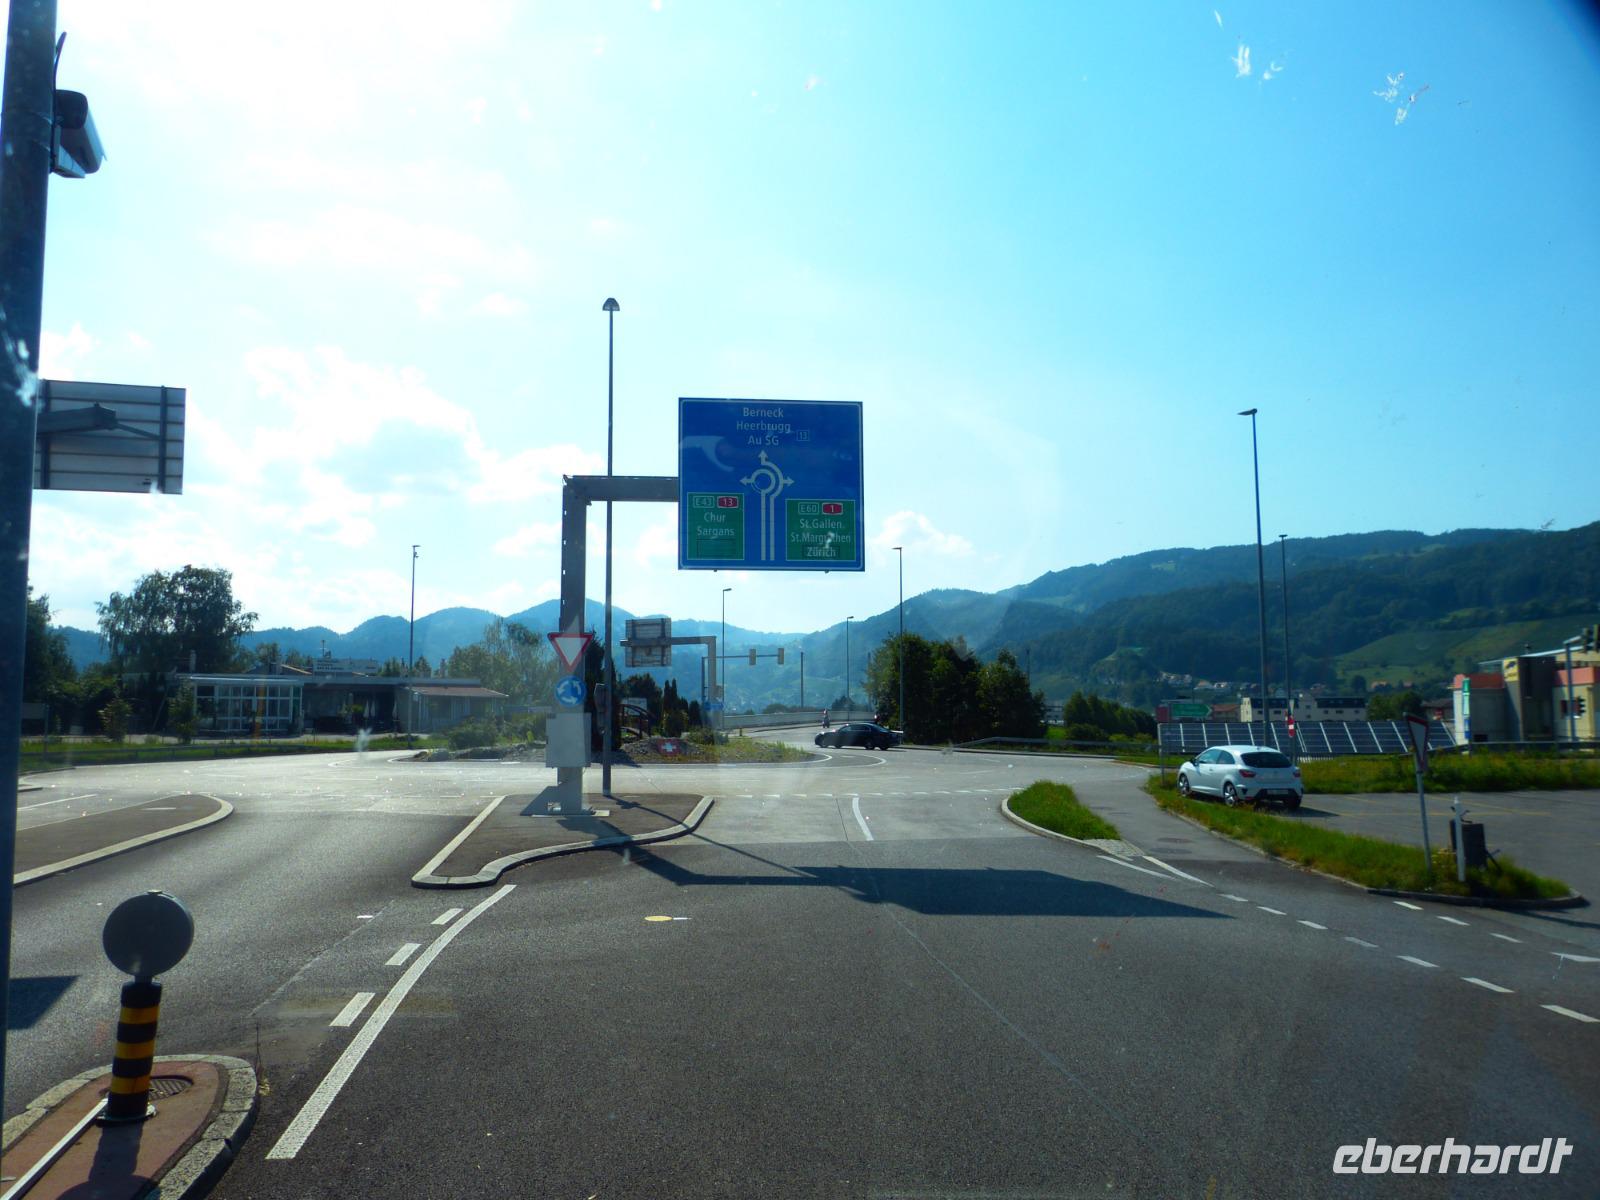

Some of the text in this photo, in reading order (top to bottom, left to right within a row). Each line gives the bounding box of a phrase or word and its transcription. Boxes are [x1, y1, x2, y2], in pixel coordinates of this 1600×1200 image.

[743, 407, 784, 418] Berneck
[736, 420, 791, 434] Heerbrugg
[747, 435, 780, 446] Au SG
[703, 511, 727, 523] Chur
[696, 526, 735, 540] Sargans
[790, 531, 851, 545] St.Margrthen
[807, 545, 837, 557] Zürich
